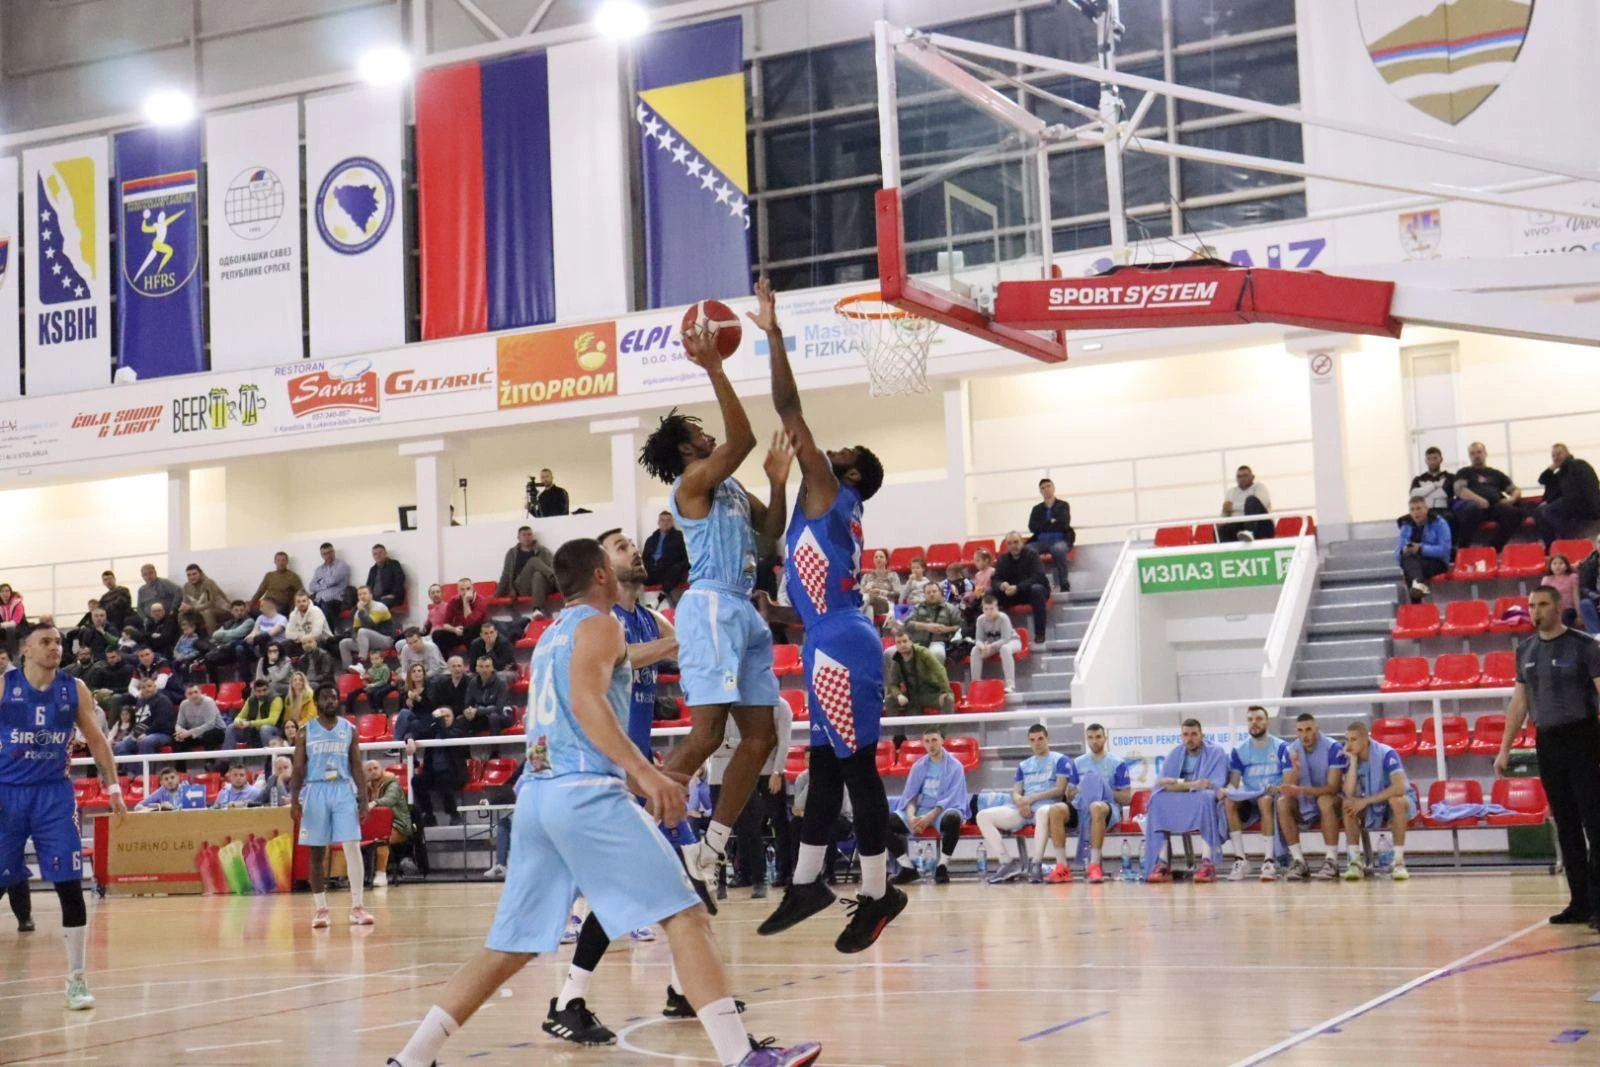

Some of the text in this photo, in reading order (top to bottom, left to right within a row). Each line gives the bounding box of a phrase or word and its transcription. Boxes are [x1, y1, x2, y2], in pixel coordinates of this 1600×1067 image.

[219, 247, 292, 266] ОДБОЈКАШКИ САВЕЗ
[220, 262, 291, 280] РЕПУБЛИКЕ СРПСКЕ
[144, 272, 176, 291] HFRS
[38, 305, 97, 346] KSBIH
[620, 325, 673, 354] ELPI
[274, 362, 325, 377] RESTORAN
[500, 371, 615, 406] ŽITOPROM
[173, 395, 207, 433] BEER
[113, 418, 161, 436] LIGHT
[1141, 557, 1271, 584] ИЗЛАЗ EXIT
[35, 706, 46, 726] 6
[1113, 734, 1153, 746] СПОРТСКО
[117, 840, 195, 853] NUTRINO LAB
[72, 851, 81, 871] 6
